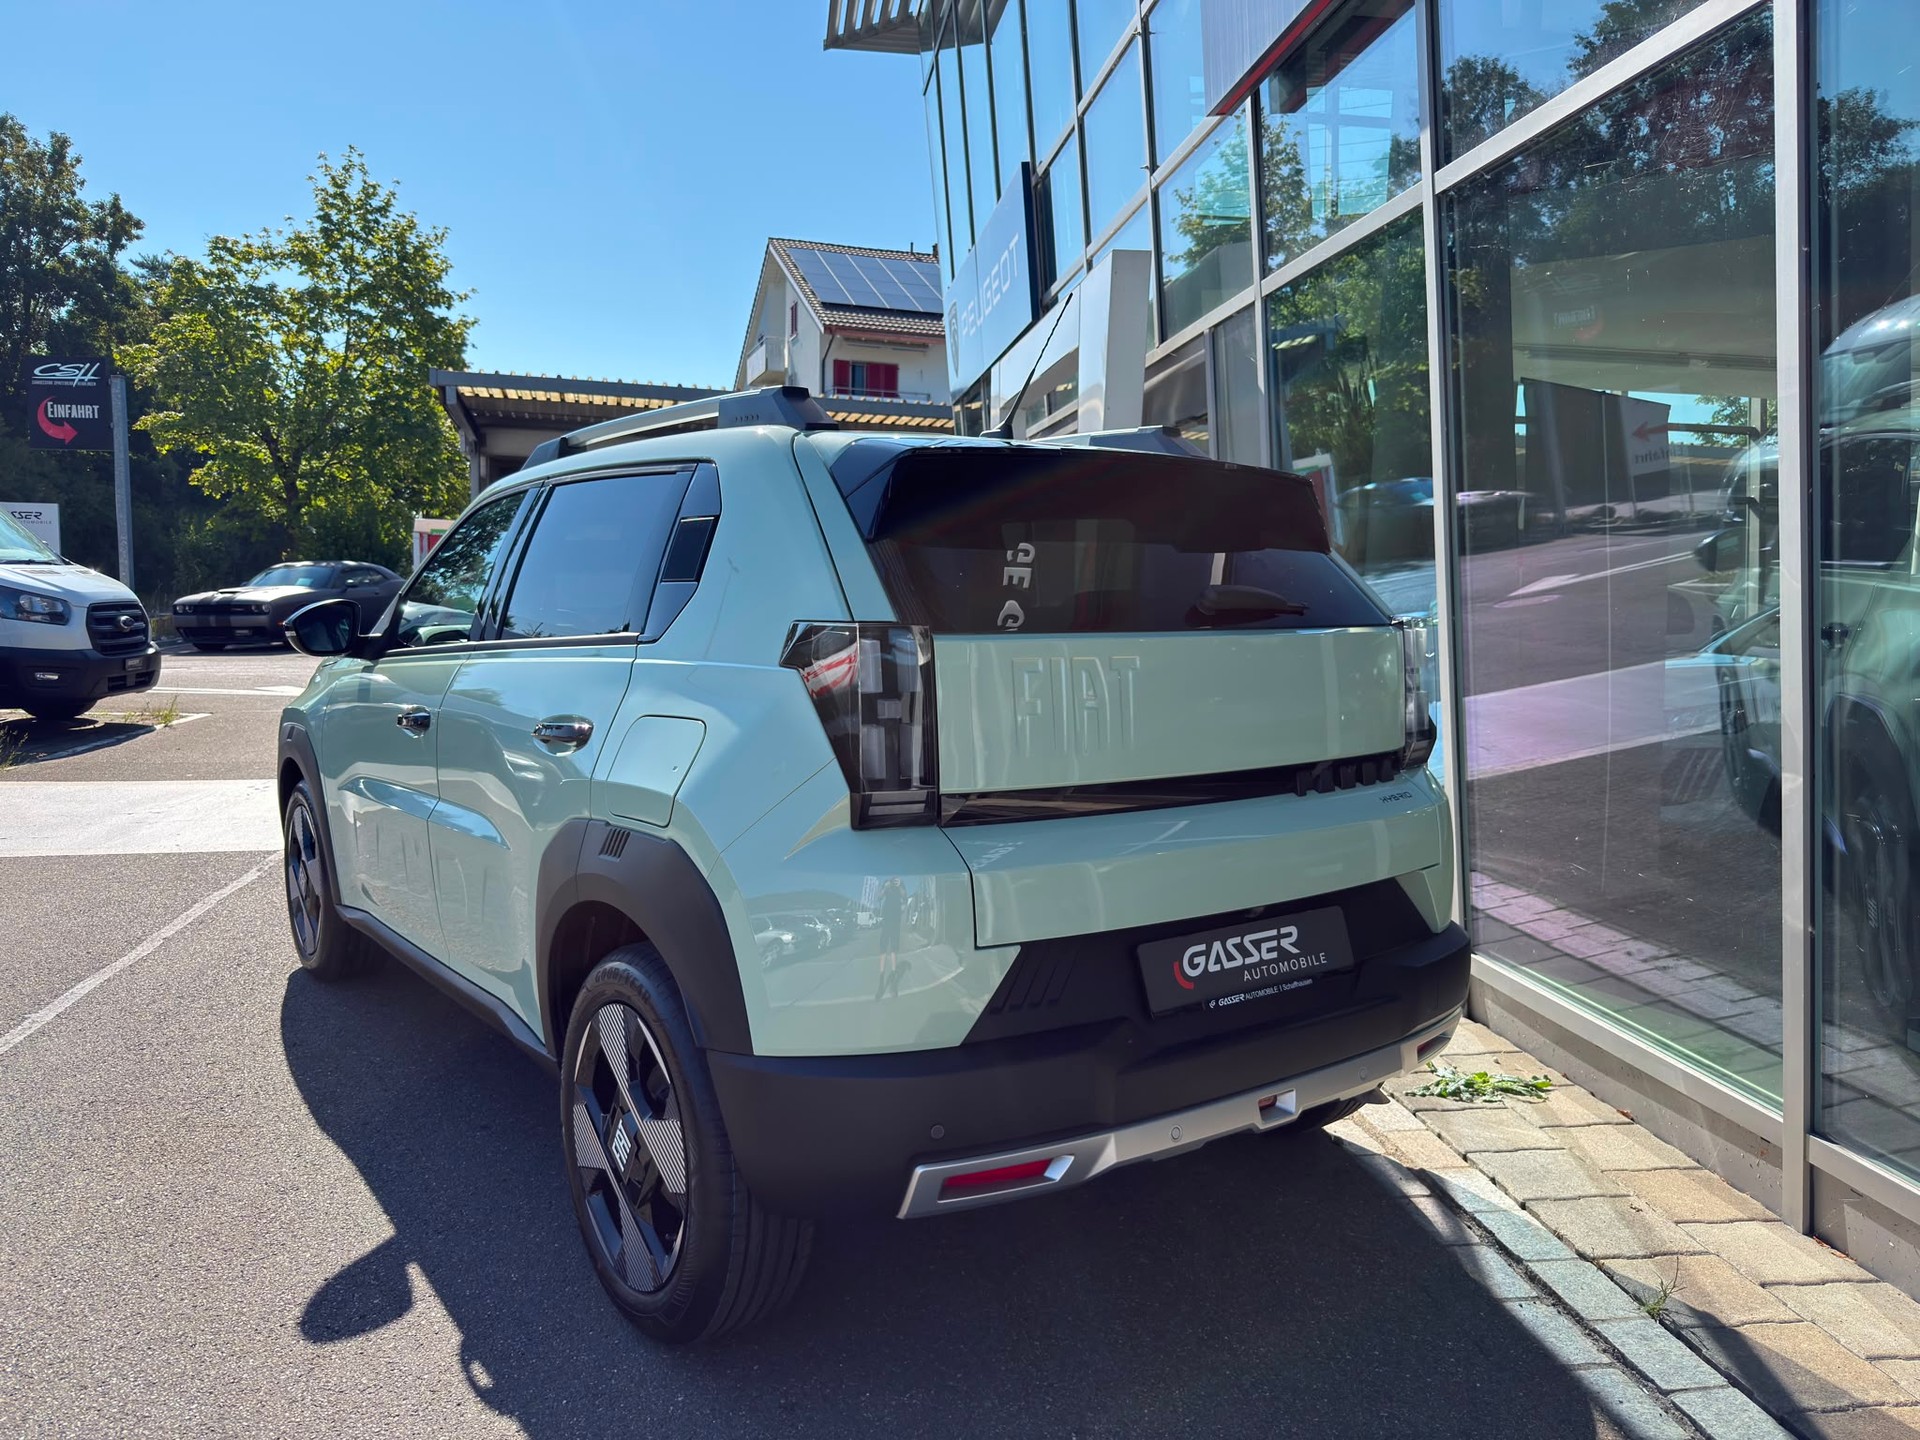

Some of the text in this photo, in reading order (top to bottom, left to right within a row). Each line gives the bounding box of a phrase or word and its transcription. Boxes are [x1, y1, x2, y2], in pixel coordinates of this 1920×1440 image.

[961, 233, 1019, 337] PEUGEOT
[47, 402, 100, 419] EINFAHRT
[8, 510, 43, 520] SSER
[1011, 654, 1140, 757] FIAT
[1182, 925, 1301, 977] GASSER
[1243, 952, 1328, 981] AUTOMOBILE
[1218, 993, 1245, 1007] GASSER
[1245, 985, 1279, 1001] AUTOMOBILE
[611, 1118, 632, 1173] FIAT
